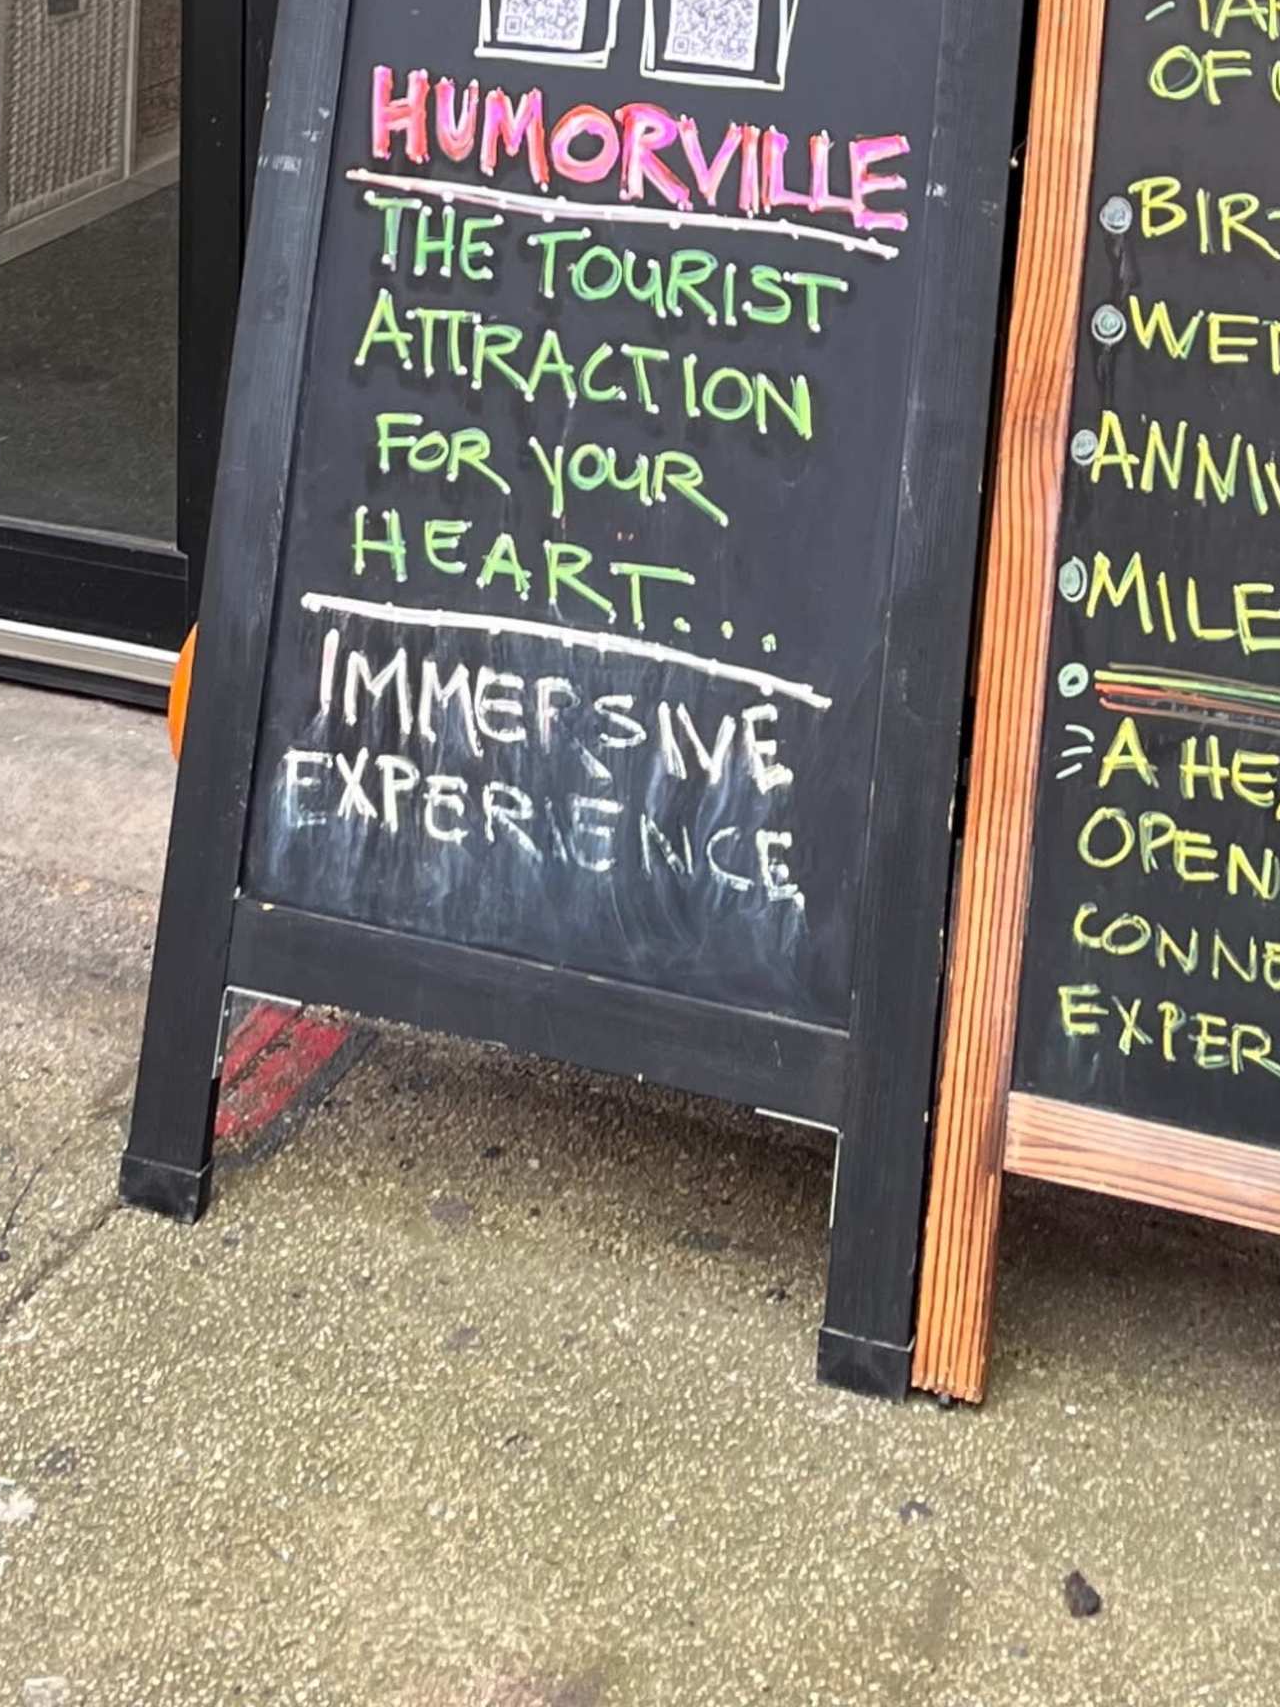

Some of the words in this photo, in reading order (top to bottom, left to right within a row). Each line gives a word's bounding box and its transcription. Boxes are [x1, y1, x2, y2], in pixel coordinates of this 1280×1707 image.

[371, 65, 911, 229] HUMORVILLE
[1149, 45, 1252, 106] OF
[365, 190, 504, 279] THE
[527, 227, 848, 332] TOURIST
[355, 288, 812, 439] ATTRACTION
[376, 412, 510, 494] FOR
[528, 437, 729, 526] YOUR
[321, 629, 794, 795] IMMERSIVE
[1098, 717, 1158, 788] A
[285, 747, 805, 909] EXPERIENCE
